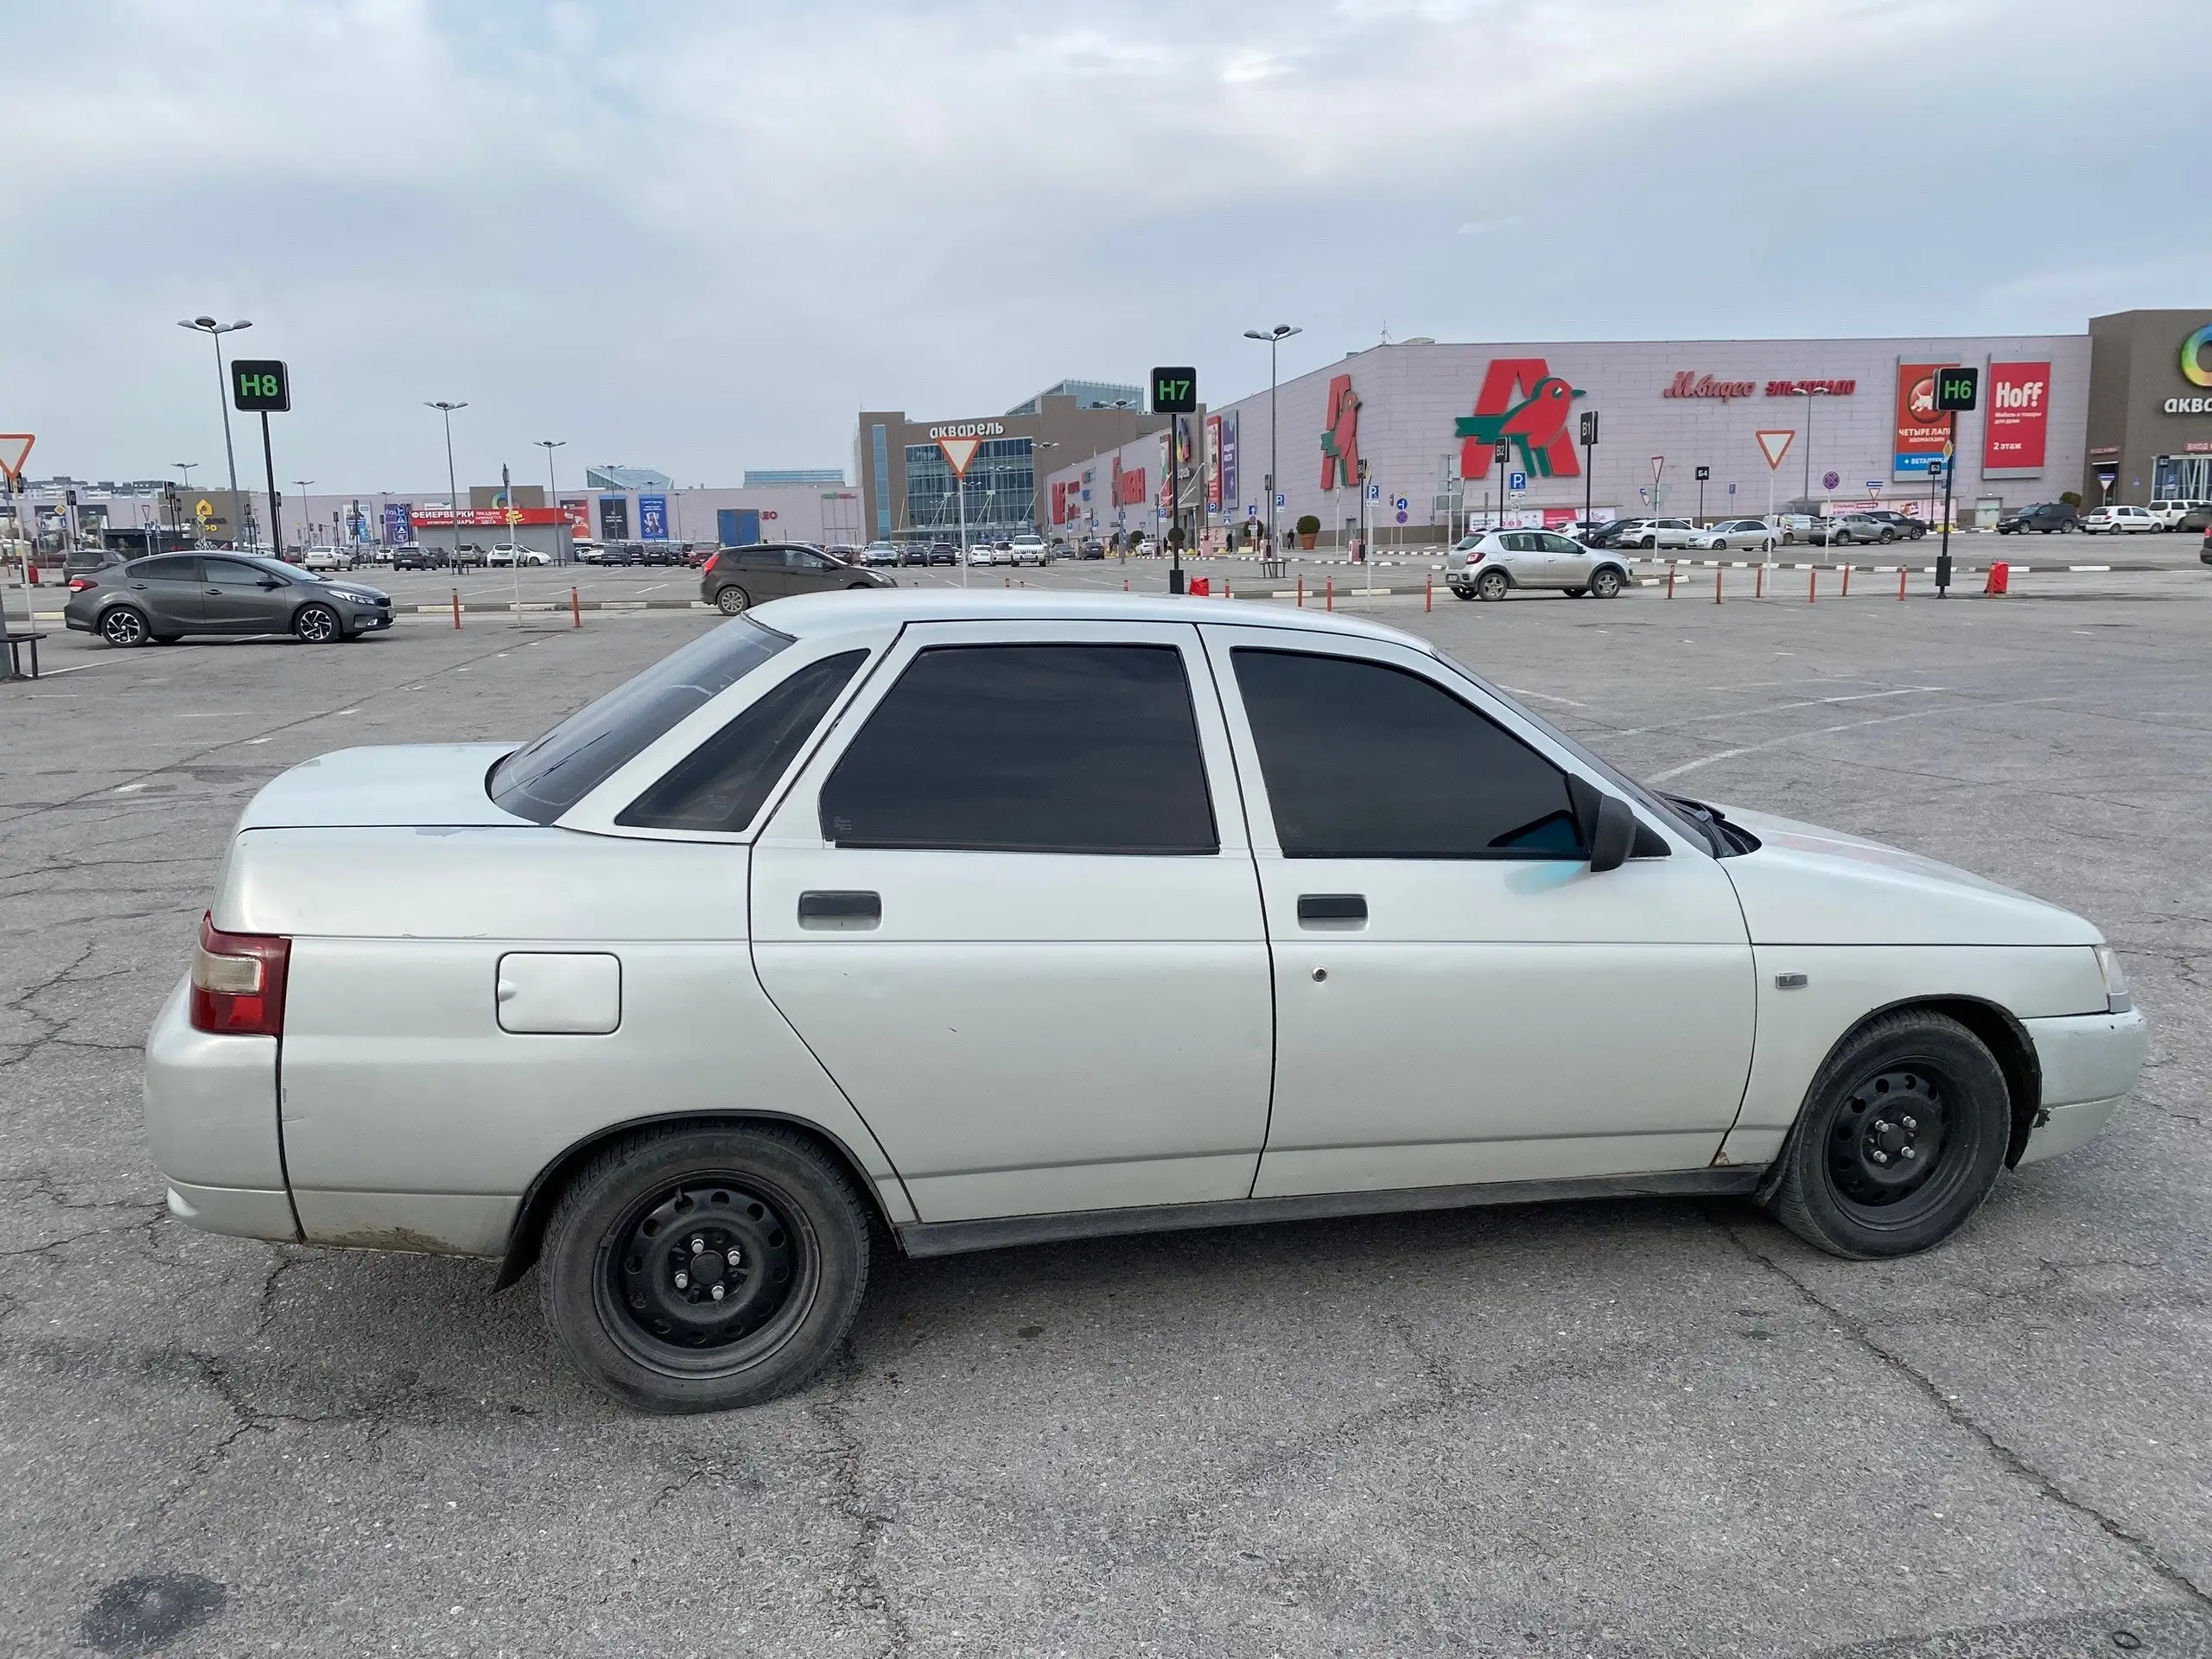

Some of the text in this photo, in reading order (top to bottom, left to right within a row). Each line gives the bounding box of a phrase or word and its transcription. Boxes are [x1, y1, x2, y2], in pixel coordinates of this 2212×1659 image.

[929, 422, 1004, 439] акварель
[1898, 428, 1930, 436] ЧЕТЫРЕ
[1514, 474, 1523, 488] P
